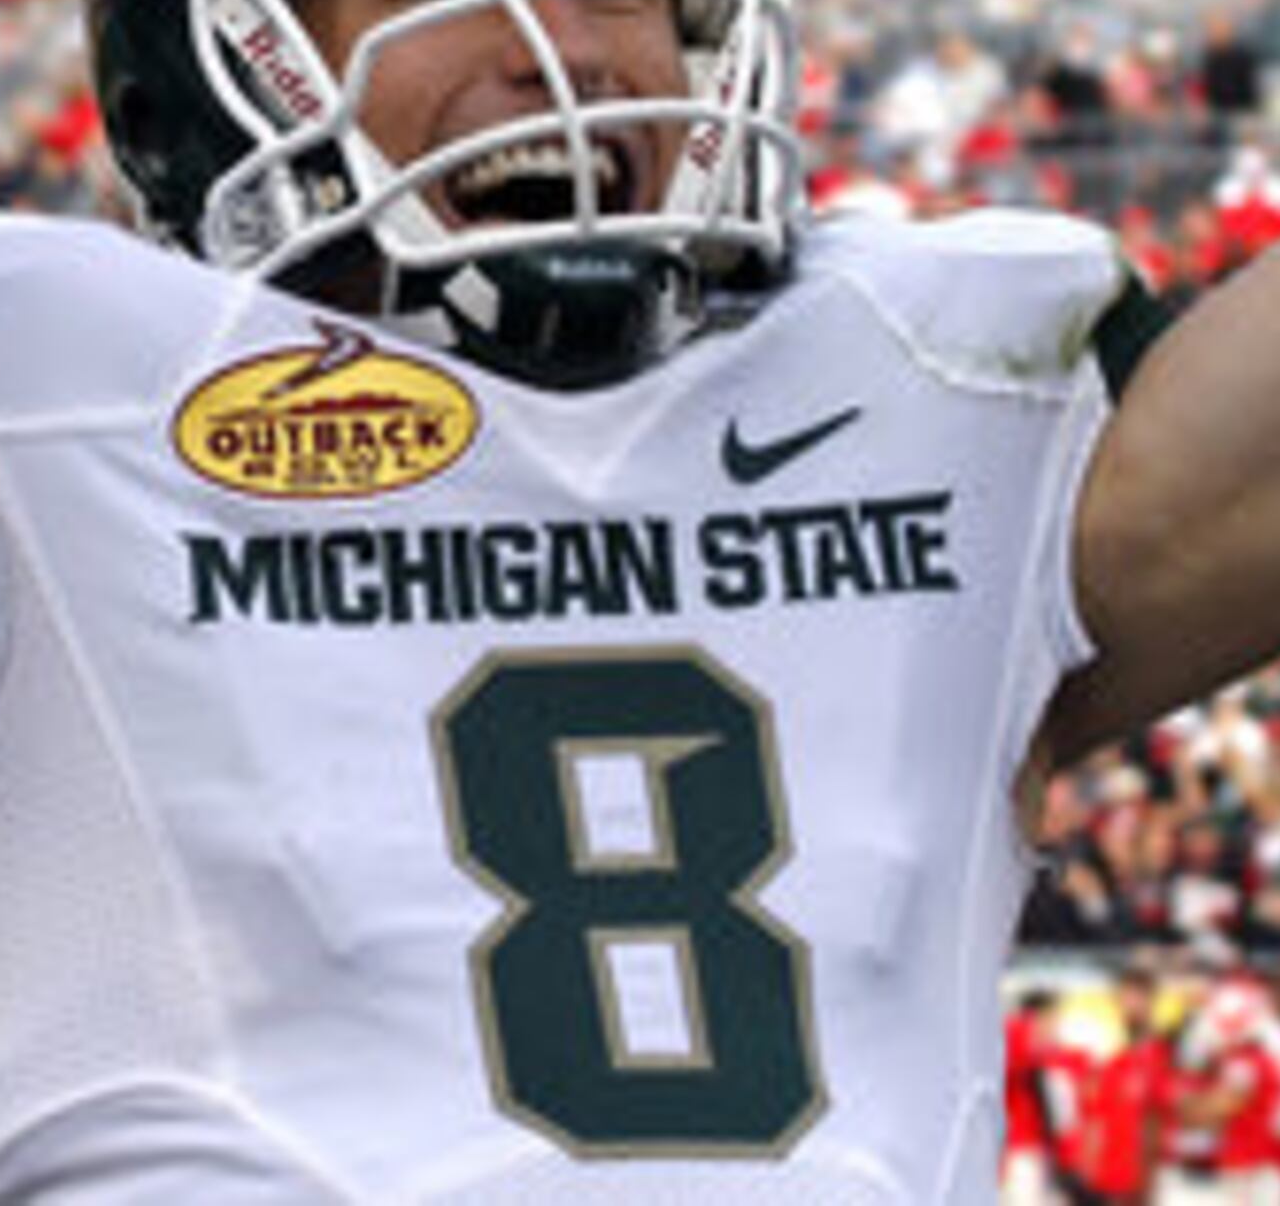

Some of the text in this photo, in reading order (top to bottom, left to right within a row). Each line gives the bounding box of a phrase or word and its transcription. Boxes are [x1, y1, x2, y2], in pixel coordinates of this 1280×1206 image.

[207, 416, 446, 460] OUTBACK
[184, 492, 957, 623] MICHIGAN STATE
[427, 643, 830, 1163] 8
